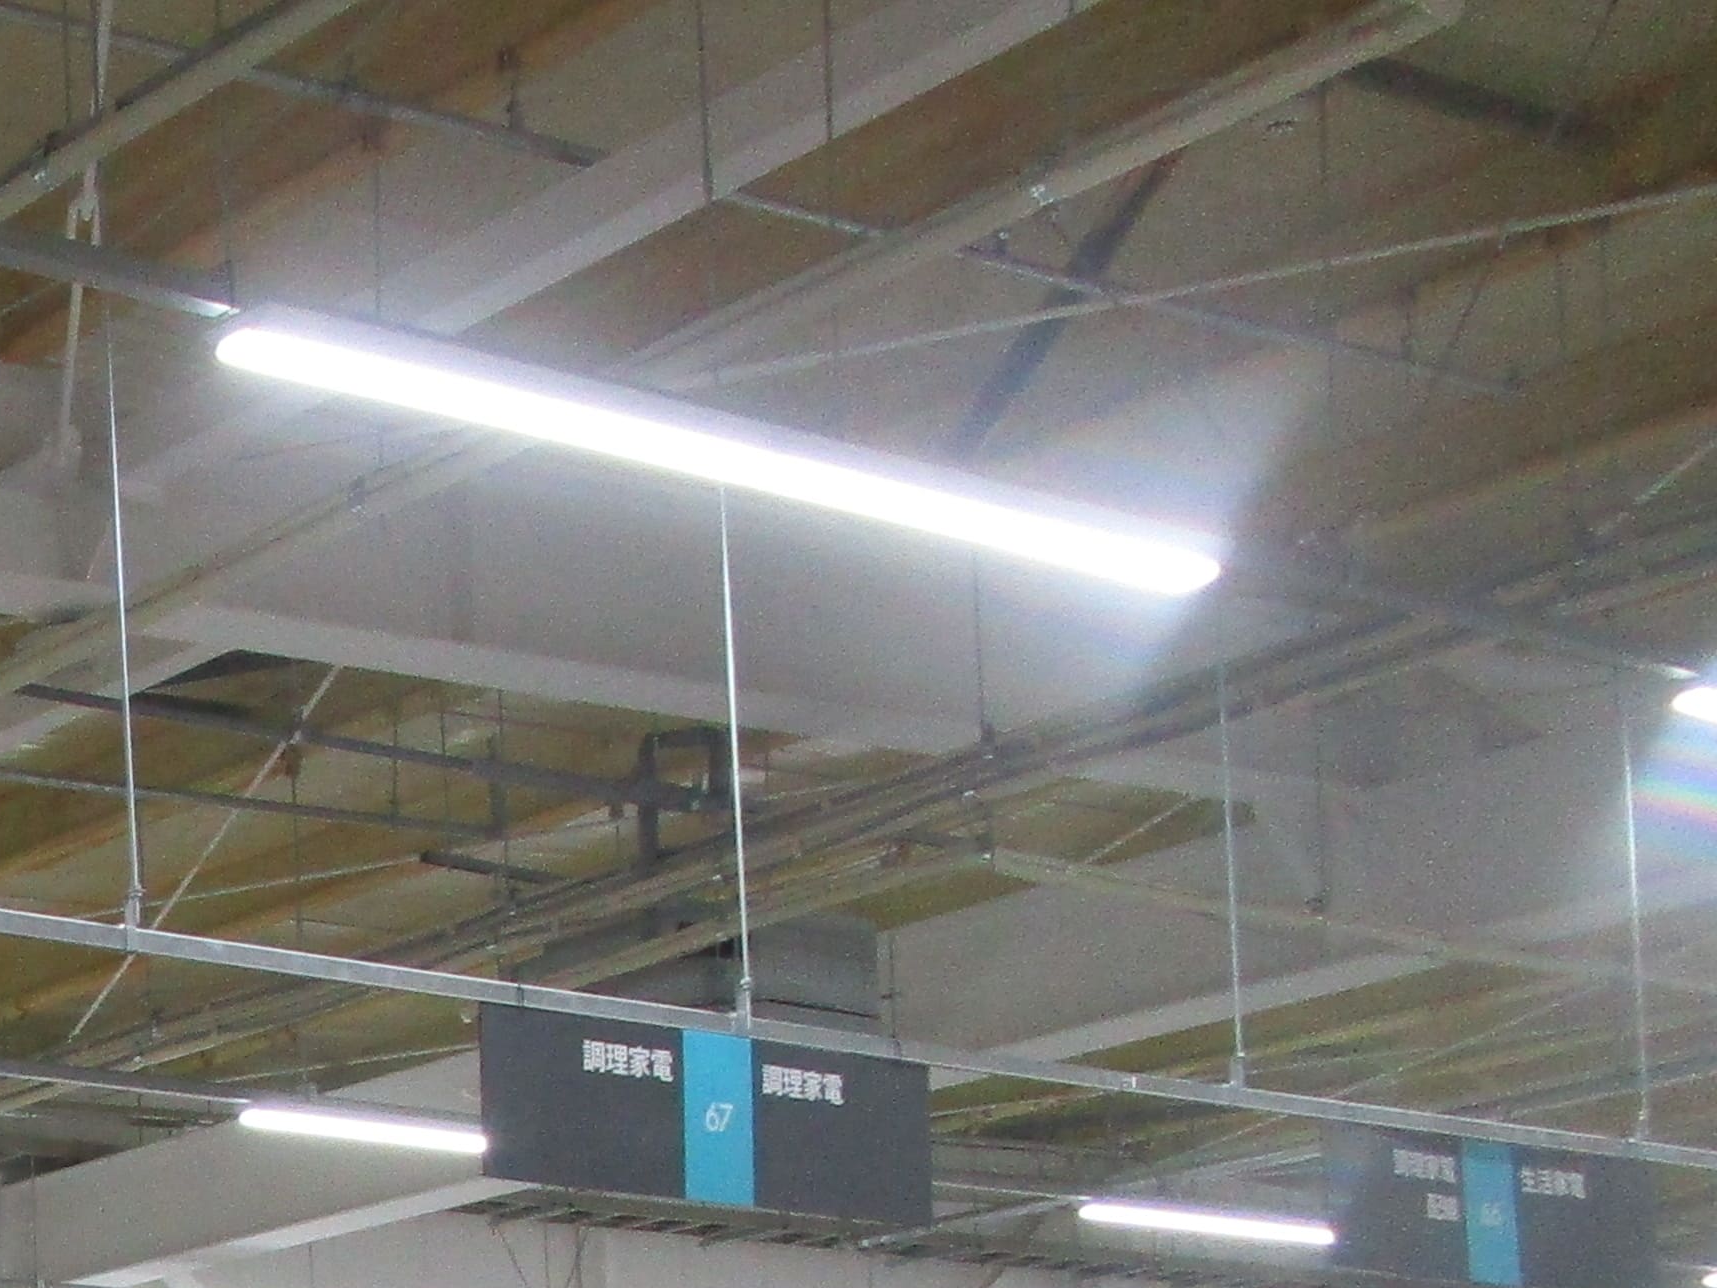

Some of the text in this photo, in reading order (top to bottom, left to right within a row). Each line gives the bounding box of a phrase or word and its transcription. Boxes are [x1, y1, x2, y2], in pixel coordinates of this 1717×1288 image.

[582, 1039, 674, 1083] 調理家電
[705, 1103, 733, 1132] 67
